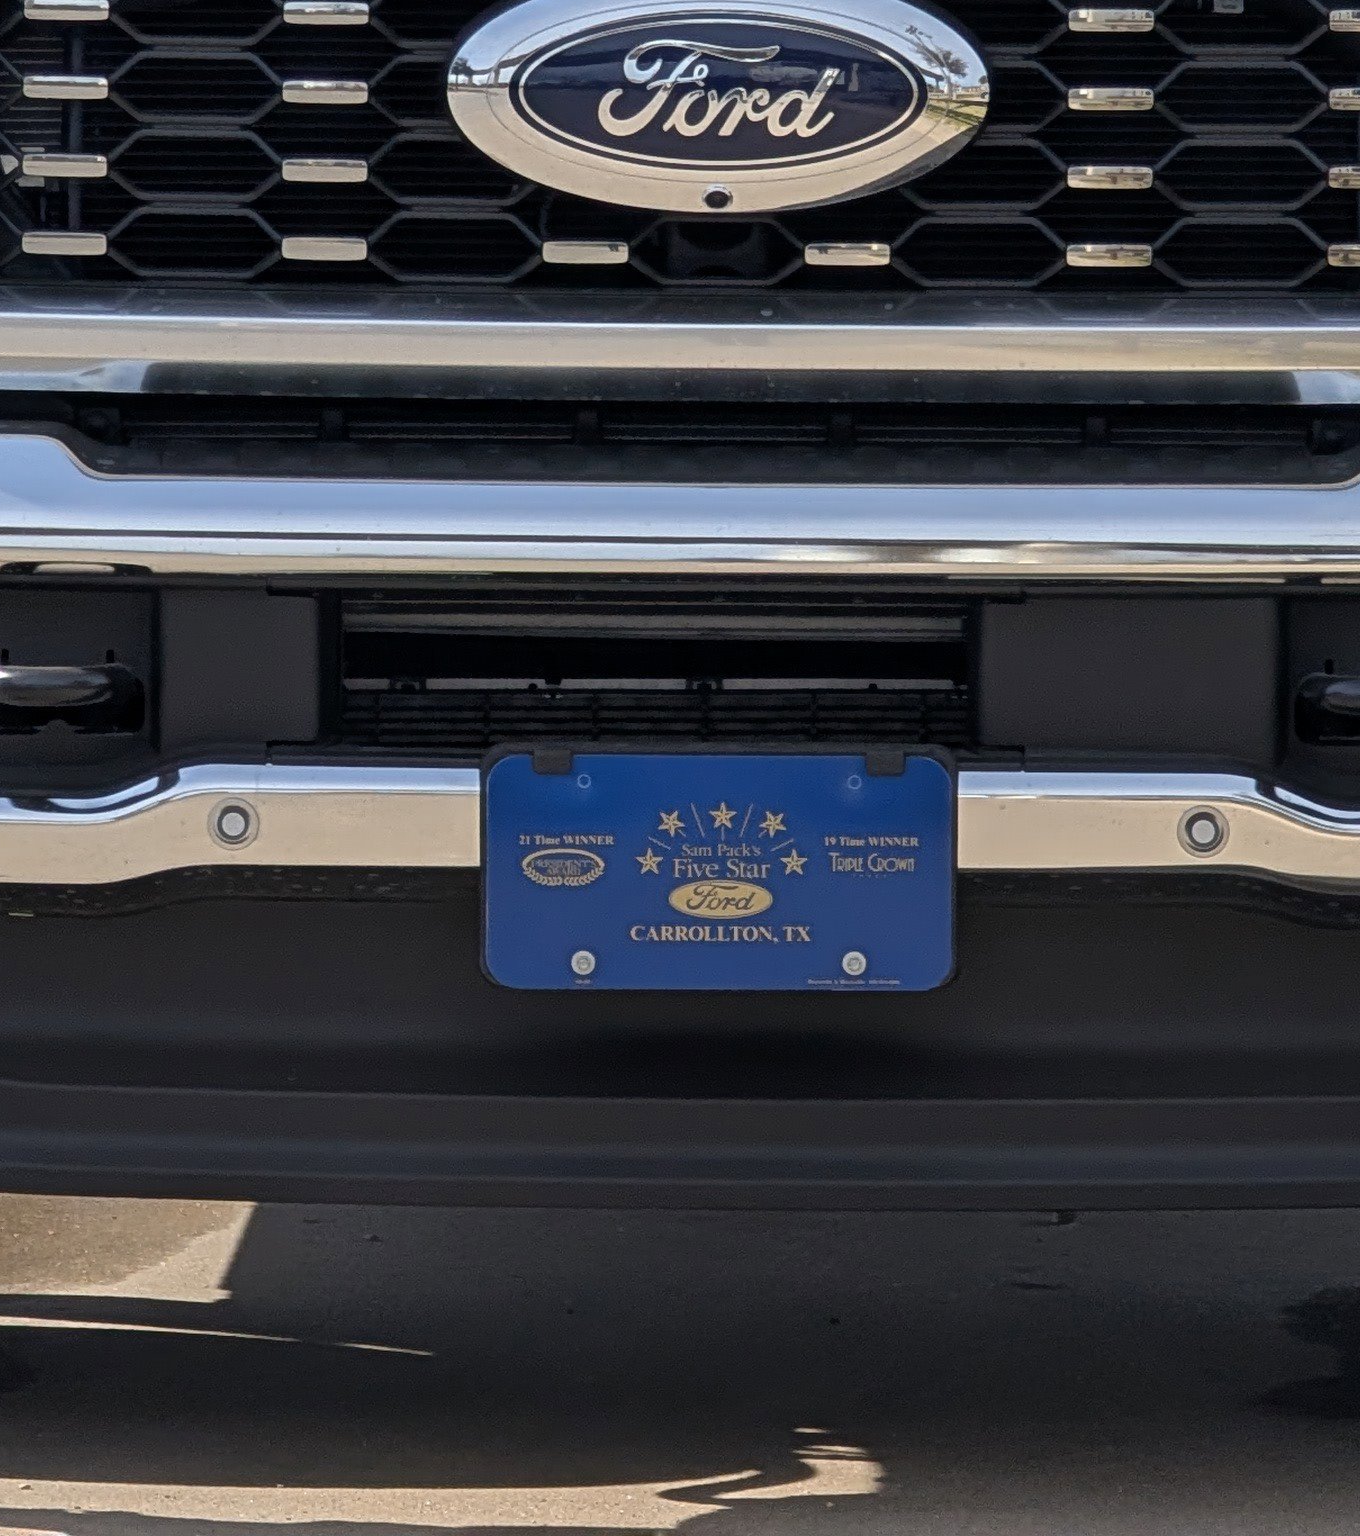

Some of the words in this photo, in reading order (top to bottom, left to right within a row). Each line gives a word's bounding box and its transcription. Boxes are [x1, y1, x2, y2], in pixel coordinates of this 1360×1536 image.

[597, 39, 839, 137] Ford
[562, 835, 614, 845] WINNER
[824, 836, 837, 846] 19
[868, 836, 919, 847] WINNER
[681, 843, 712, 857] Sam
[717, 843, 762, 857] Pack's
[673, 858, 720, 878] Five
[726, 858, 771, 879] Star
[686, 884, 756, 911] Ford
[629, 925, 780, 944] CARROLLTON,
[782, 925, 812, 942] TX
